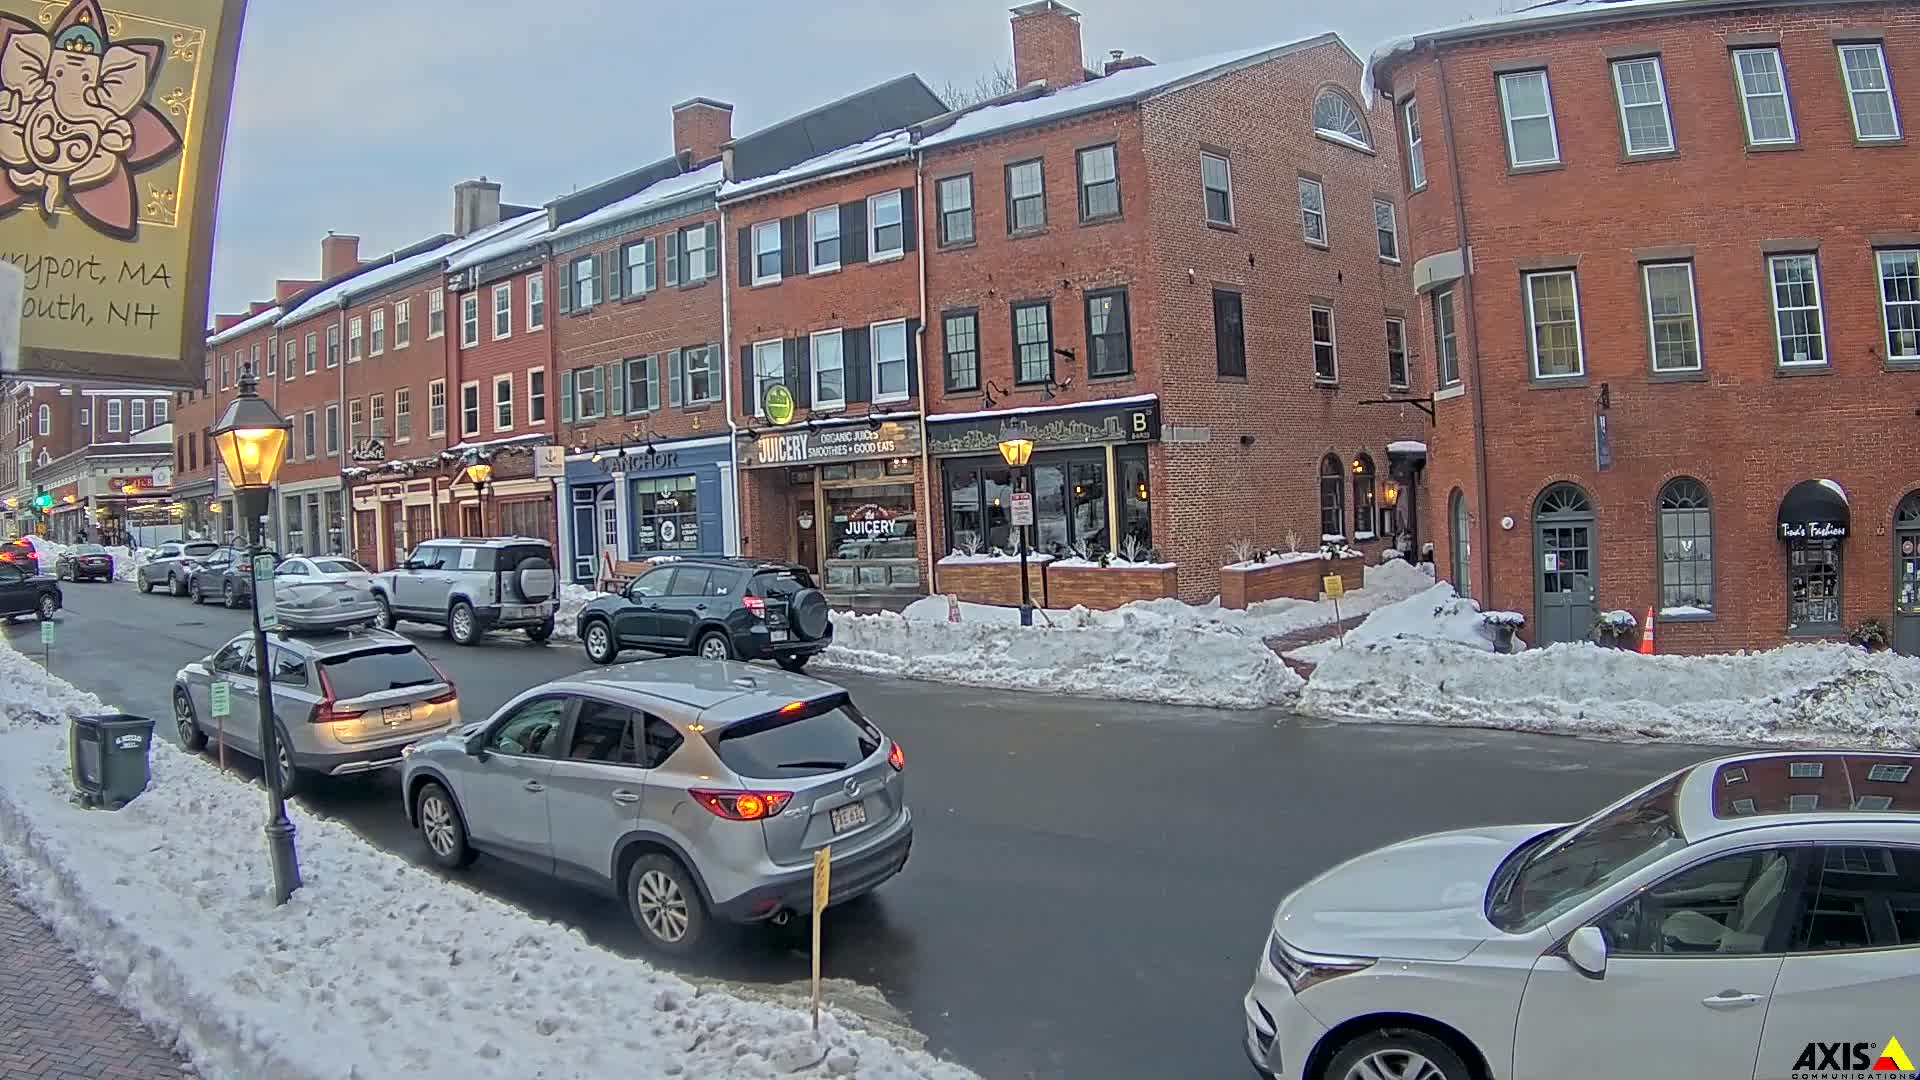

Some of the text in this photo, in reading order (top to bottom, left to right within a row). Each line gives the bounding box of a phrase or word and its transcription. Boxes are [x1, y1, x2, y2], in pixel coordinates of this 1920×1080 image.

[1, 252, 172, 290] ryport, MA
[107, 302, 161, 329] NH
[1133, 412, 1147, 432] B
[820, 431, 853, 444] ORGANIC
[759, 433, 808, 463] JUICERY
[808, 440, 895, 458] SMOOTHIES GOOD EATS
[611, 451, 679, 472] ANCHOR
[845, 519, 896, 535] JUICERY
[1809, 522, 1845, 537] Fashion
